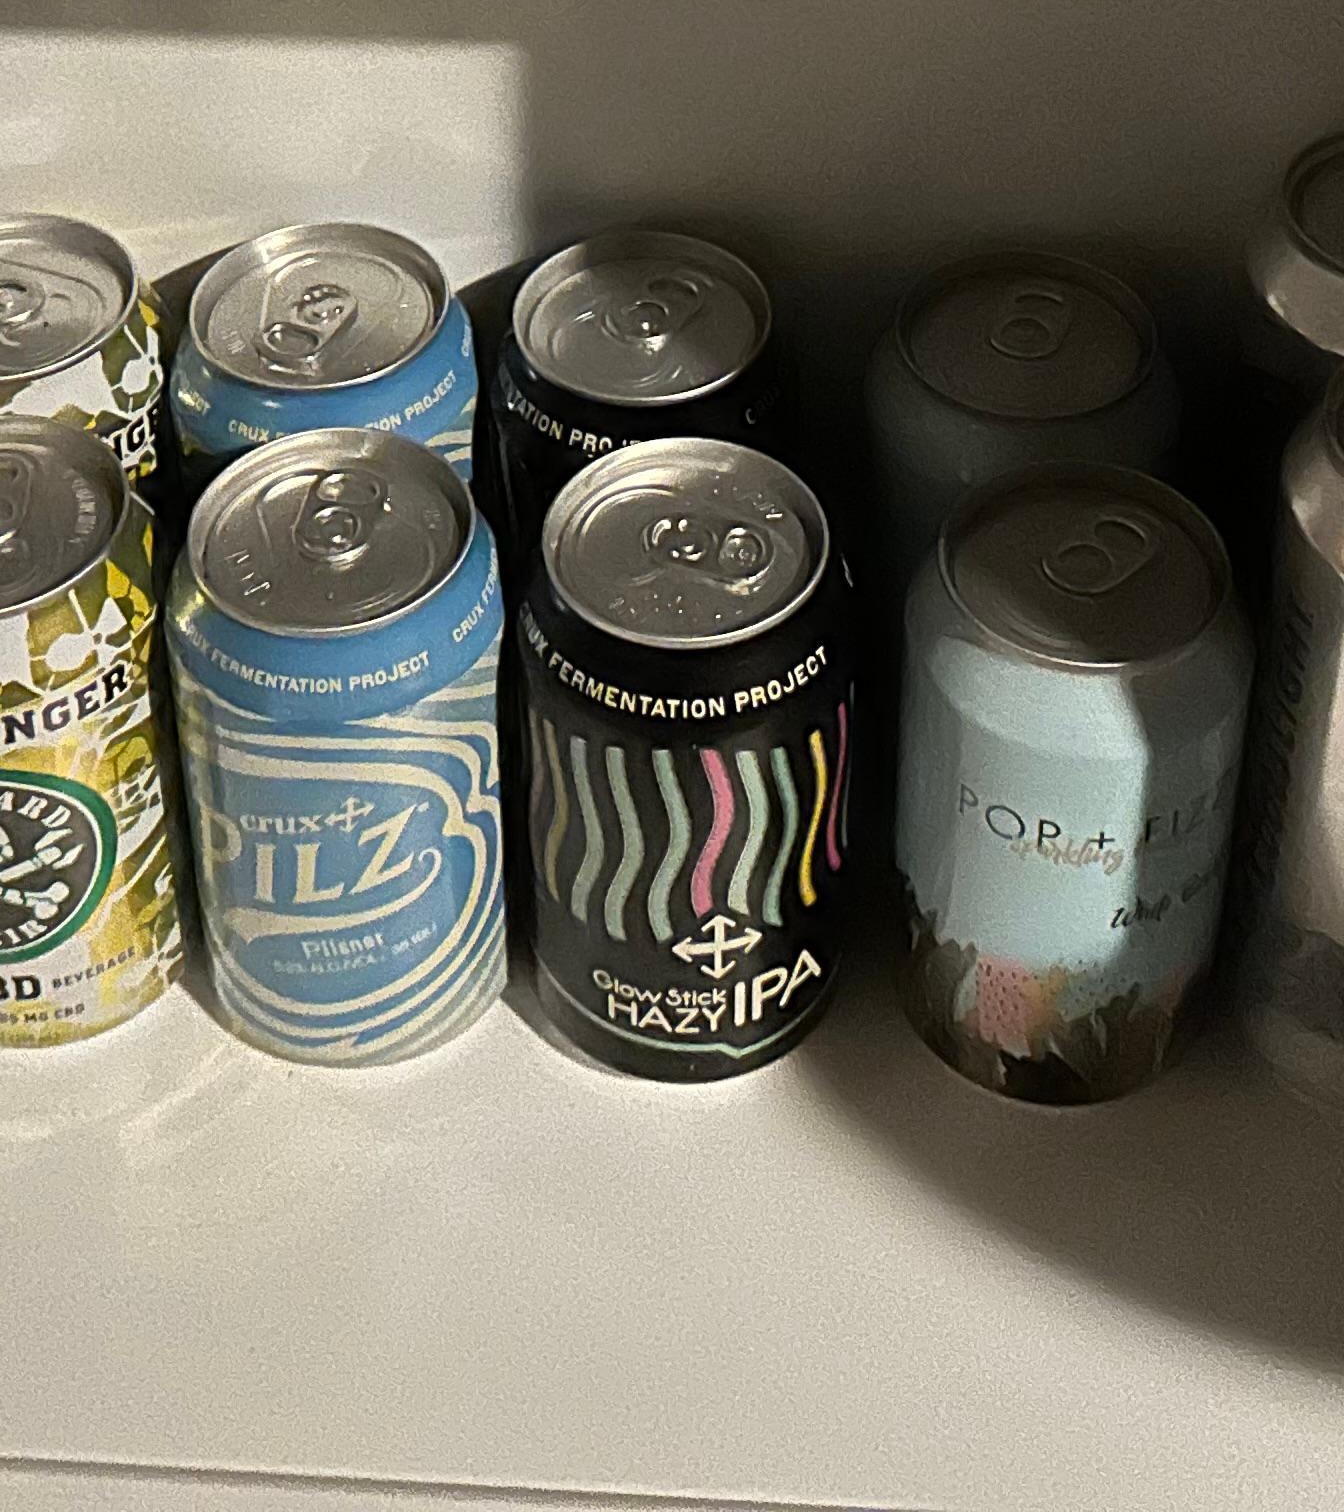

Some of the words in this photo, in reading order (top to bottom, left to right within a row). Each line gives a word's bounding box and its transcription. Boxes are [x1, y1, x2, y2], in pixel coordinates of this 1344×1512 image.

[404, 369, 457, 422] PROJECT
[227, 418, 270, 444] CRUX
[452, 601, 485, 644] CRUX
[210, 646, 342, 694] FERMENTATION
[348, 650, 430, 691] PROJECT
[547, 650, 726, 720] FERMENTATION
[734, 645, 829, 714] PROJECT
[239, 813, 323, 836] crux
[957, 783, 1061, 850] POP
[201, 801, 430, 905] PILZ
[52, 945, 137, 990] BEVERAGE
[300, 932, 385, 961] Pilsner
[592, 969, 662, 1005] Glow
[665, 987, 727, 1008] Stick
[607, 993, 727, 1034] HAZY
[733, 948, 822, 1028] IPA
